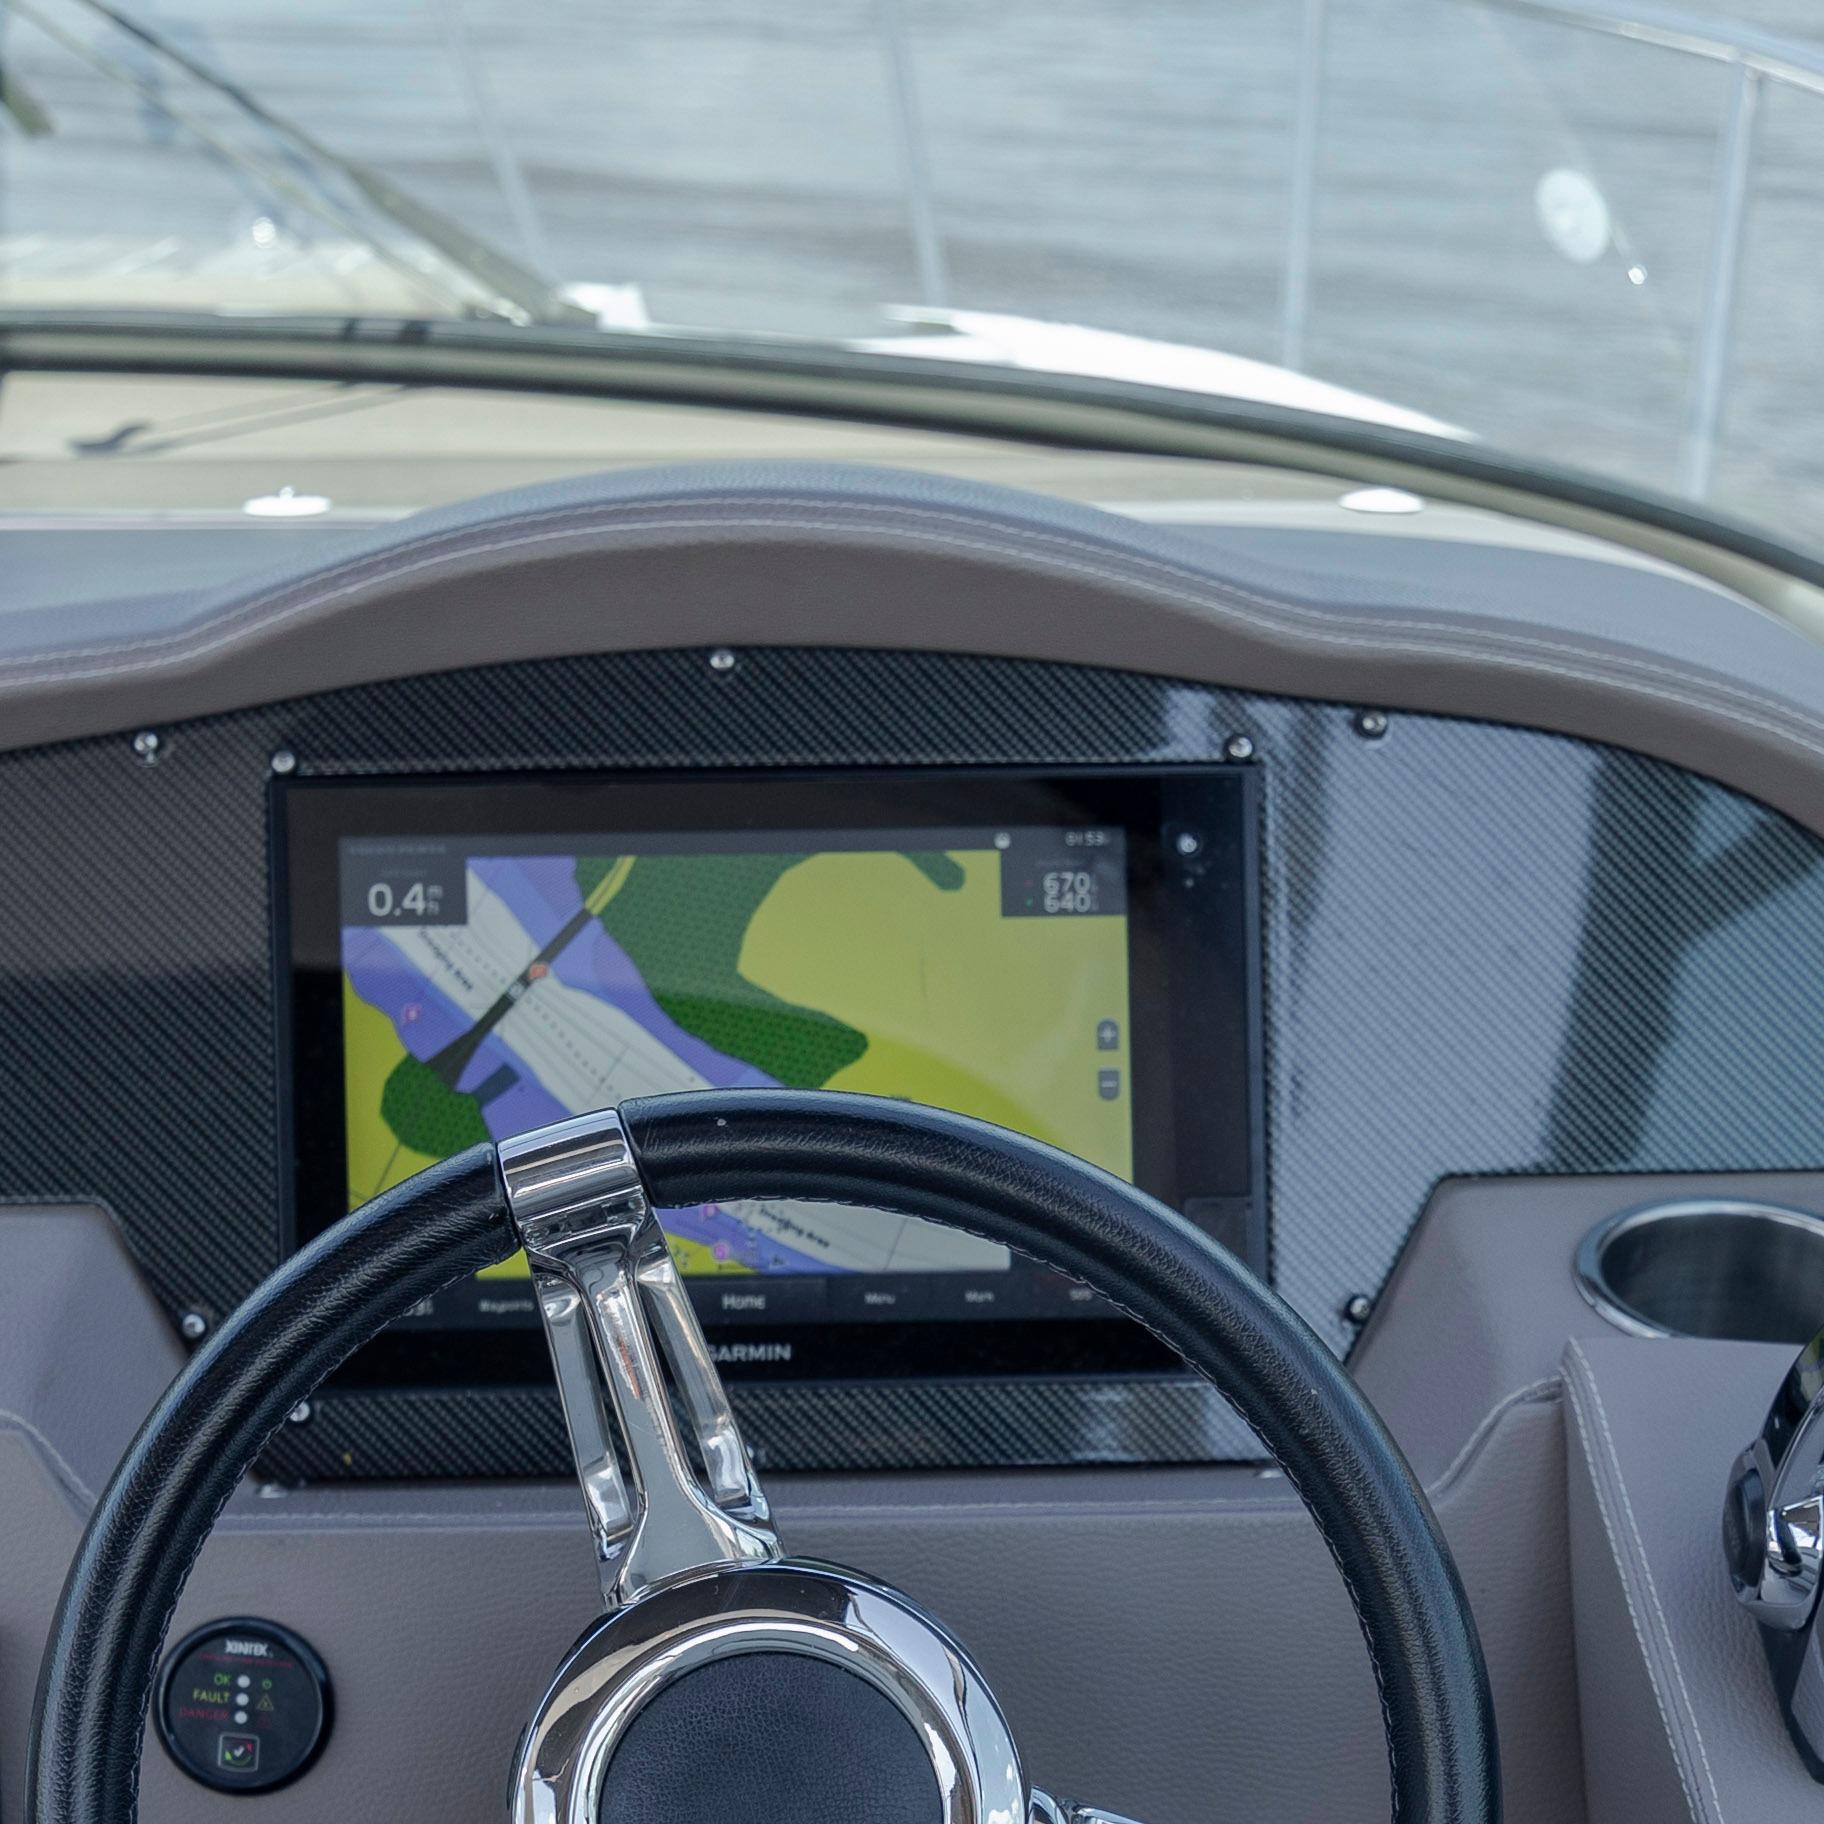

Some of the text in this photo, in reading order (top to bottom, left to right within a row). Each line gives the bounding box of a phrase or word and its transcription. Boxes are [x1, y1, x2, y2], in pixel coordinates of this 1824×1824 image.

[1043, 871, 1091, 894] 670
[367, 882, 426, 917] 0.4
[1044, 892, 1092, 913] 640
[722, 1293, 766, 1310] Home
[213, 1672, 232, 1687] OK
[192, 1687, 230, 1705] FAULT
